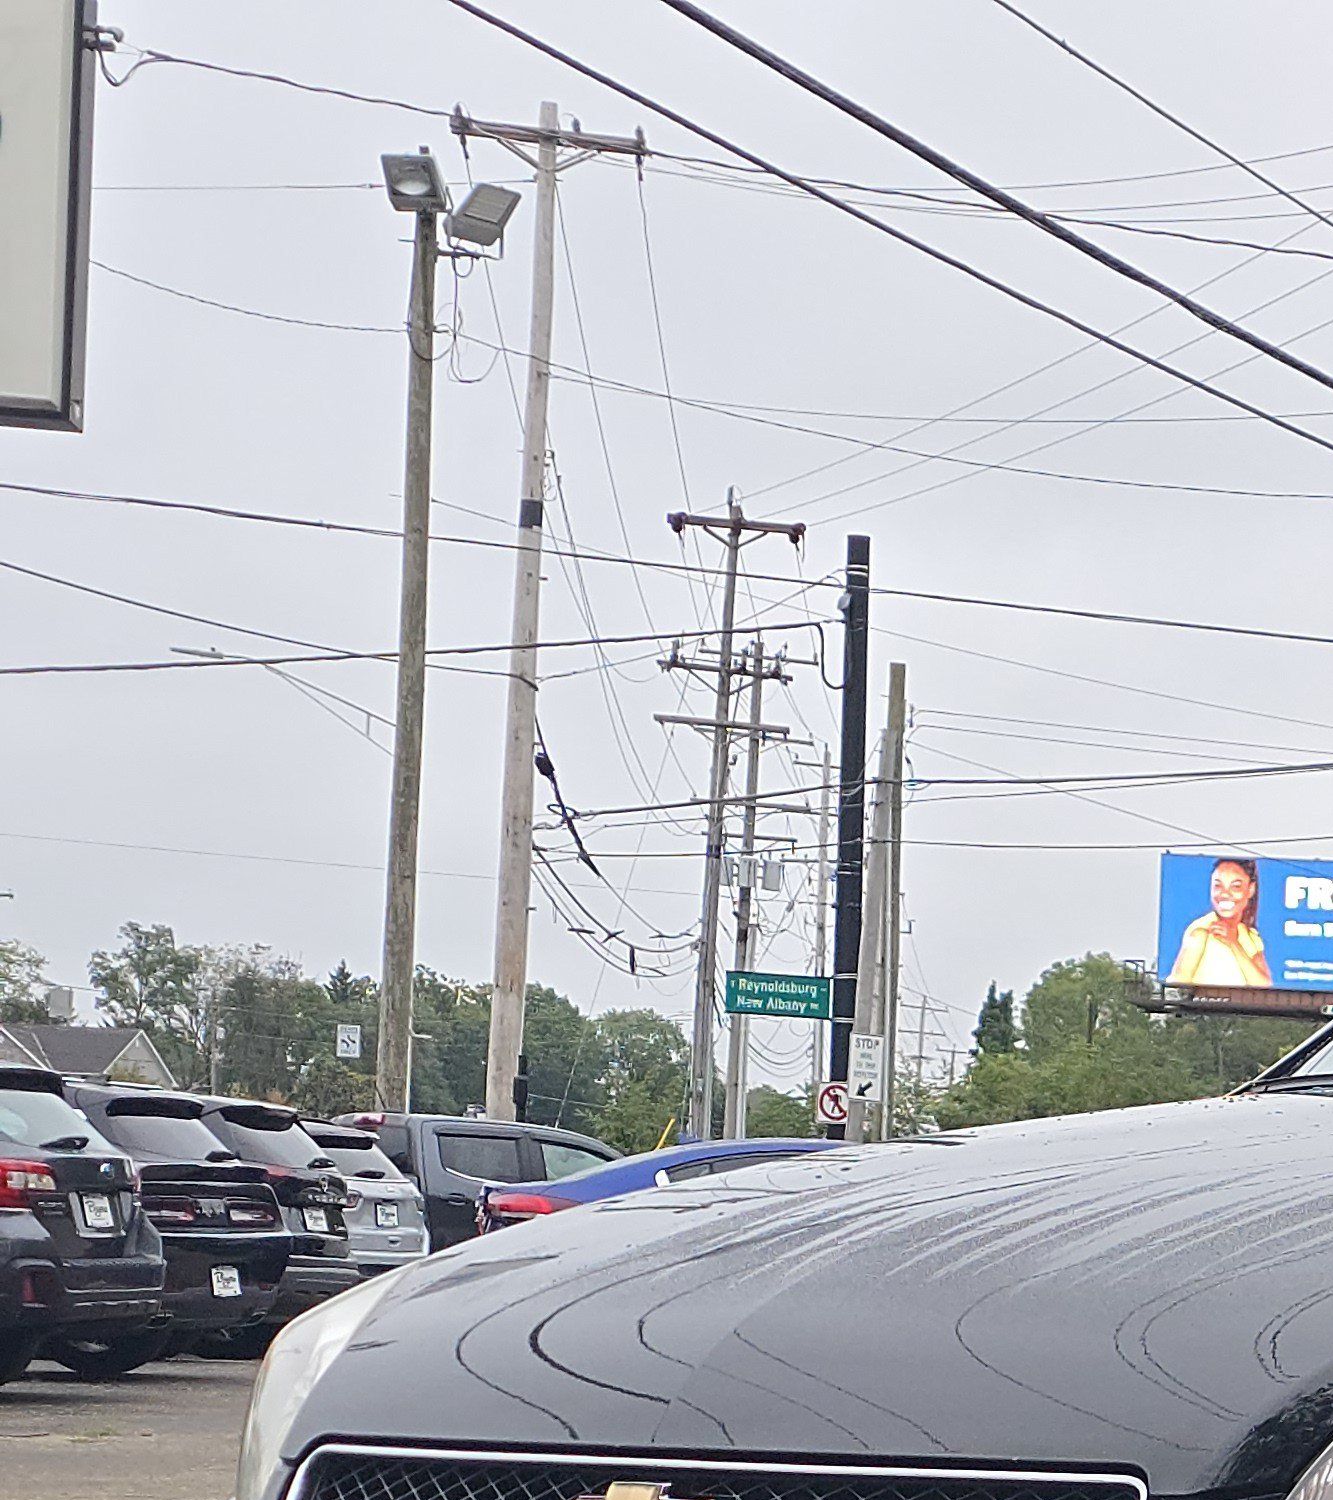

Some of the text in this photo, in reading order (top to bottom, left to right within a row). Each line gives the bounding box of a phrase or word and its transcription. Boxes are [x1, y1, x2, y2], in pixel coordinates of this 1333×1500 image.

[738, 978, 818, 998] Reynoldsburg
[736, 995, 764, 1009] New
[766, 996, 806, 1014] Albany
[855, 1038, 879, 1049] STOP
